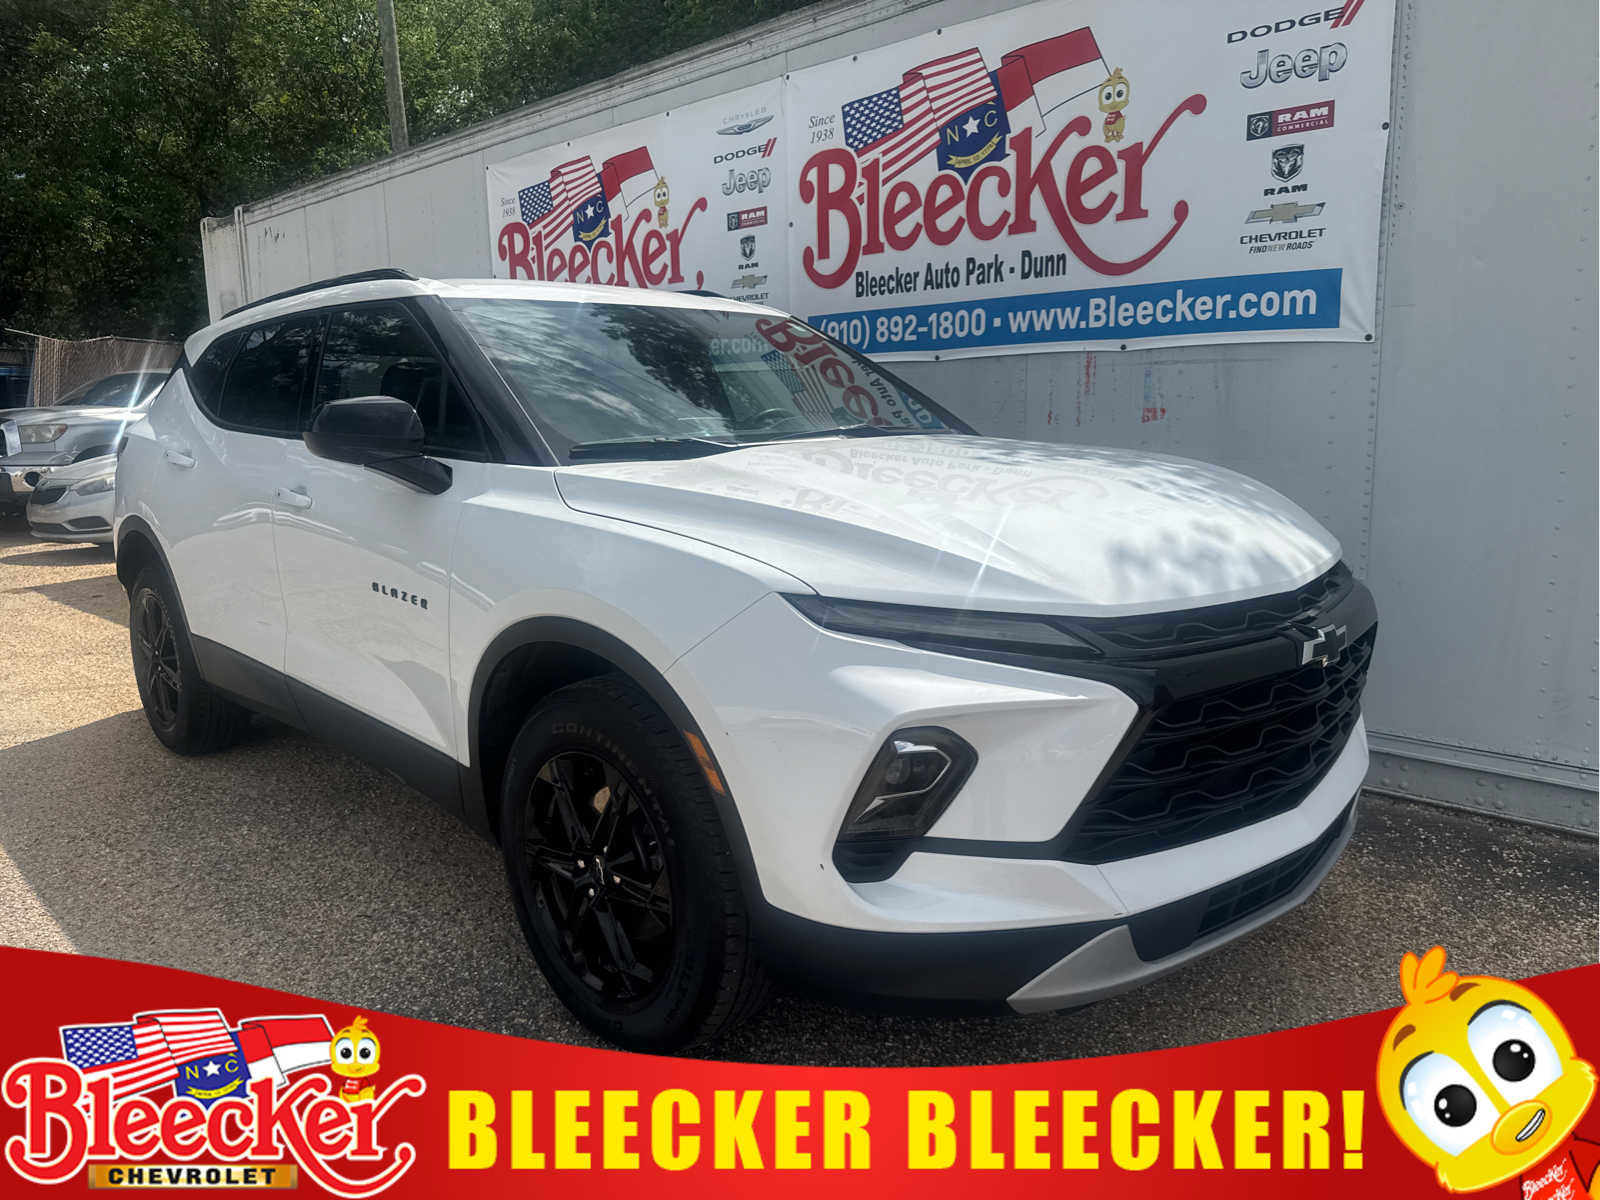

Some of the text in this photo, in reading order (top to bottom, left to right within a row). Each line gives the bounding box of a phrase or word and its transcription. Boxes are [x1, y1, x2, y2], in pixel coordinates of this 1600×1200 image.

[1227, 6, 1346, 43] DODGE
[1240, 42, 1348, 89] Jeep
[809, 114, 836, 128] Since
[1278, 106, 1328, 123] RAM
[946, 110, 999, 145] N C
[1277, 119, 1328, 132] COMMERCIAL
[810, 127, 834, 144] 1938
[713, 145, 768, 164] DODGE
[722, 166, 771, 196] Jeep
[1264, 183, 1308, 197] RAM
[799, 94, 1207, 289] Bleecker
[741, 210, 765, 220] RAM
[498, 197, 708, 290] Bleecker
[1240, 228, 1327, 245] CHEVROLET
[1286, 240, 1314, 251] ROADS
[738, 262, 759, 270] RAM
[856, 267, 919, 298] Bleecker
[923, 262, 960, 291] Auto
[965, 253, 1005, 286] Park
[1021, 250, 1067, 280] Dunn
[730, 292, 768, 302] HEVROLET
[821, 288, 1318, 350] (910) 892-1800 www.Bleecker.com
[372, 582, 428, 610] BLAZER
